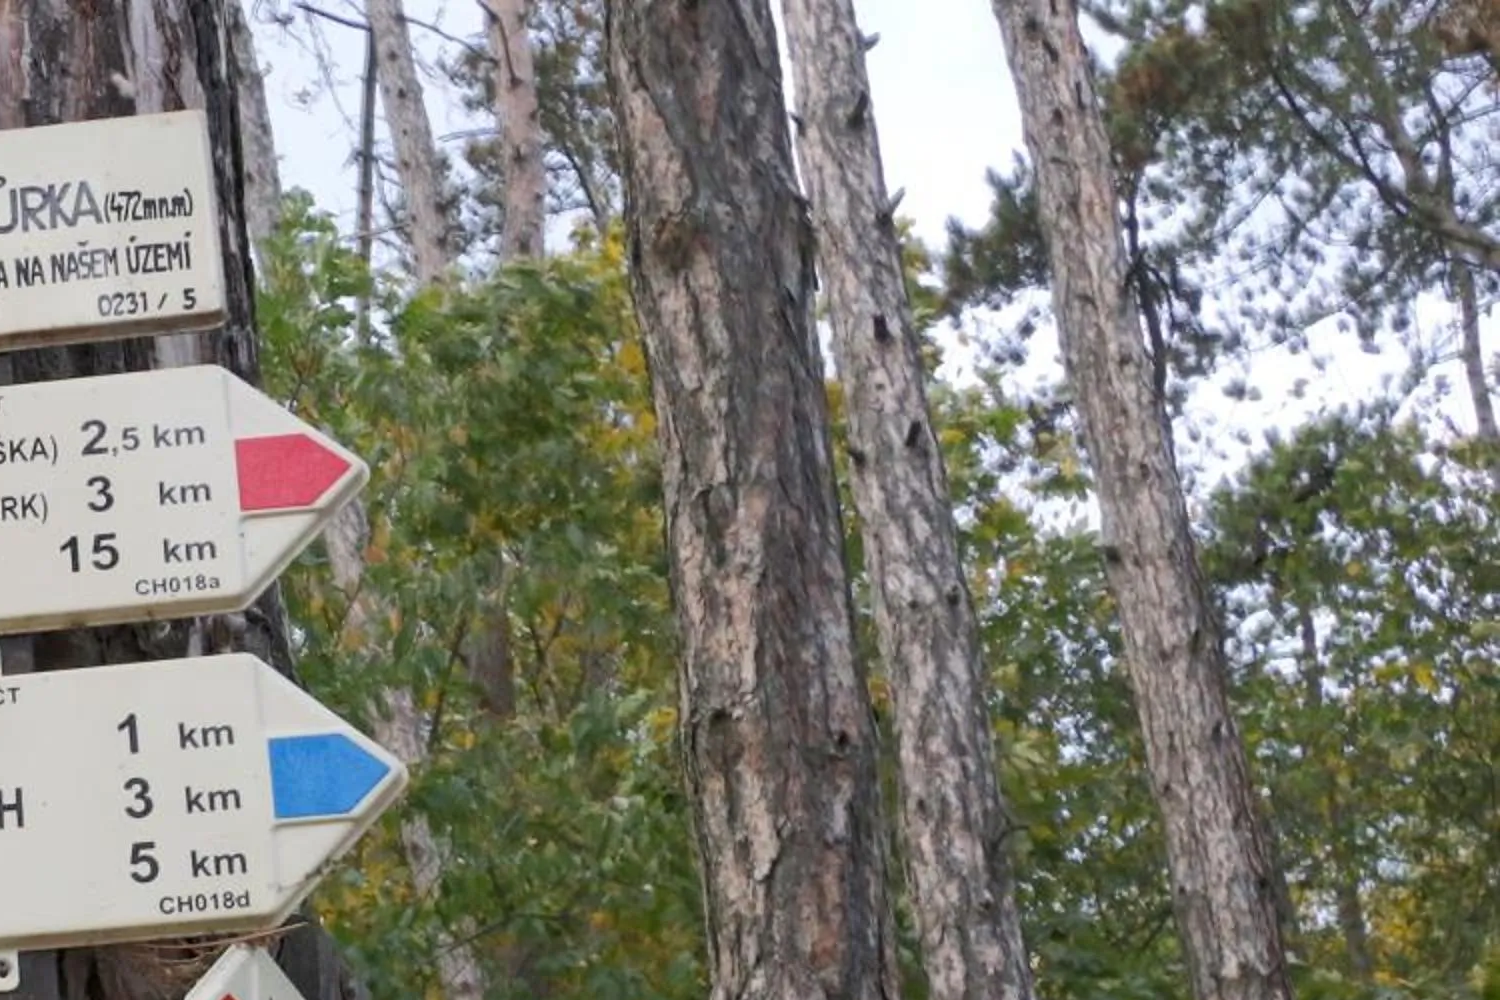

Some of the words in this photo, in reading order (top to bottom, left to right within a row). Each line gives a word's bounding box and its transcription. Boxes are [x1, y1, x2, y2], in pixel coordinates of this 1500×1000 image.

[15, 261, 46, 288] NA
[50, 241, 119, 283] NAŠEM
[125, 232, 191, 274] ÚZEMÍ
[98, 291, 148, 316] 0231
[81, 419, 140, 456] 2,5
[153, 424, 205, 448] km
[87, 475, 114, 512] 3
[159, 481, 211, 505] km
[60, 532, 119, 573] 15
[163, 539, 217, 563] km
[135, 574, 220, 595] CH018a
[117, 713, 139, 754] 1
[178, 722, 234, 749] km
[124, 777, 154, 819] 3
[185, 786, 241, 814] km
[130, 841, 160, 884] 5
[190, 850, 247, 878] km
[159, 890, 250, 915] CH018d
